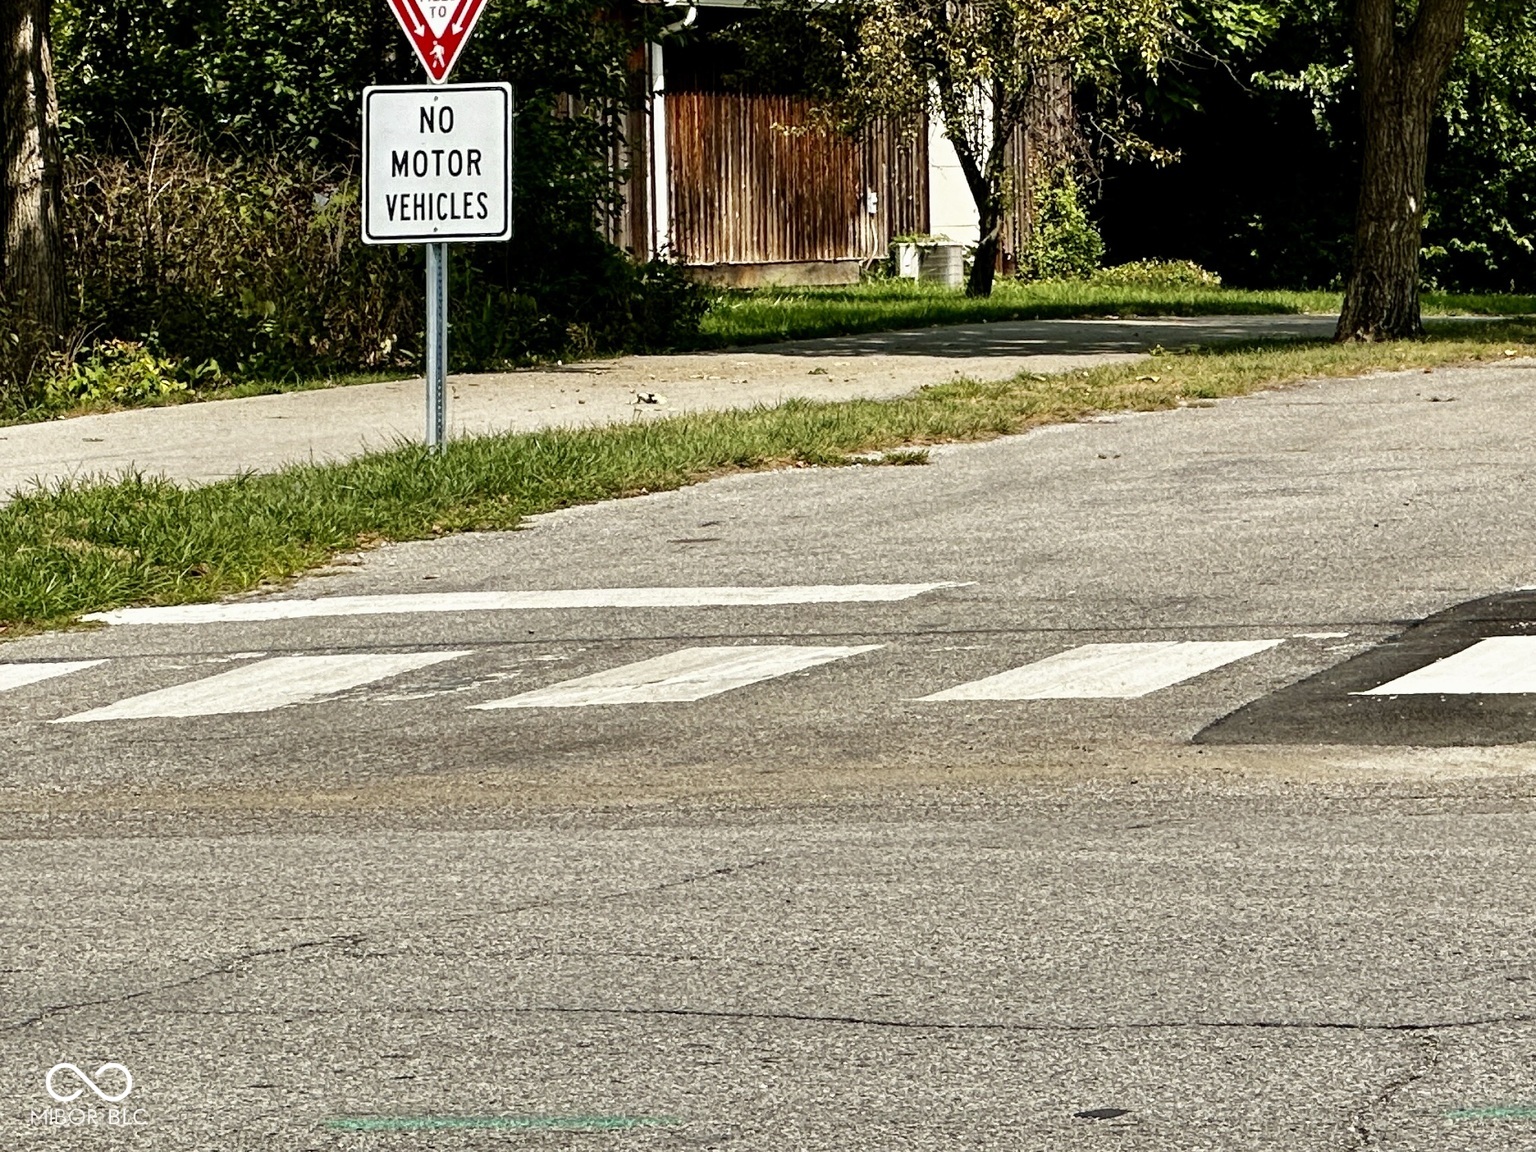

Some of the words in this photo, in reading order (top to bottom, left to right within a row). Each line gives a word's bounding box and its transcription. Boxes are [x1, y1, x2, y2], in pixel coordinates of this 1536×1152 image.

[430, 5, 447, 19] TO
[419, 106, 455, 134] NO
[391, 149, 482, 178] MOTOR
[385, 192, 489, 222] VEHICLES
